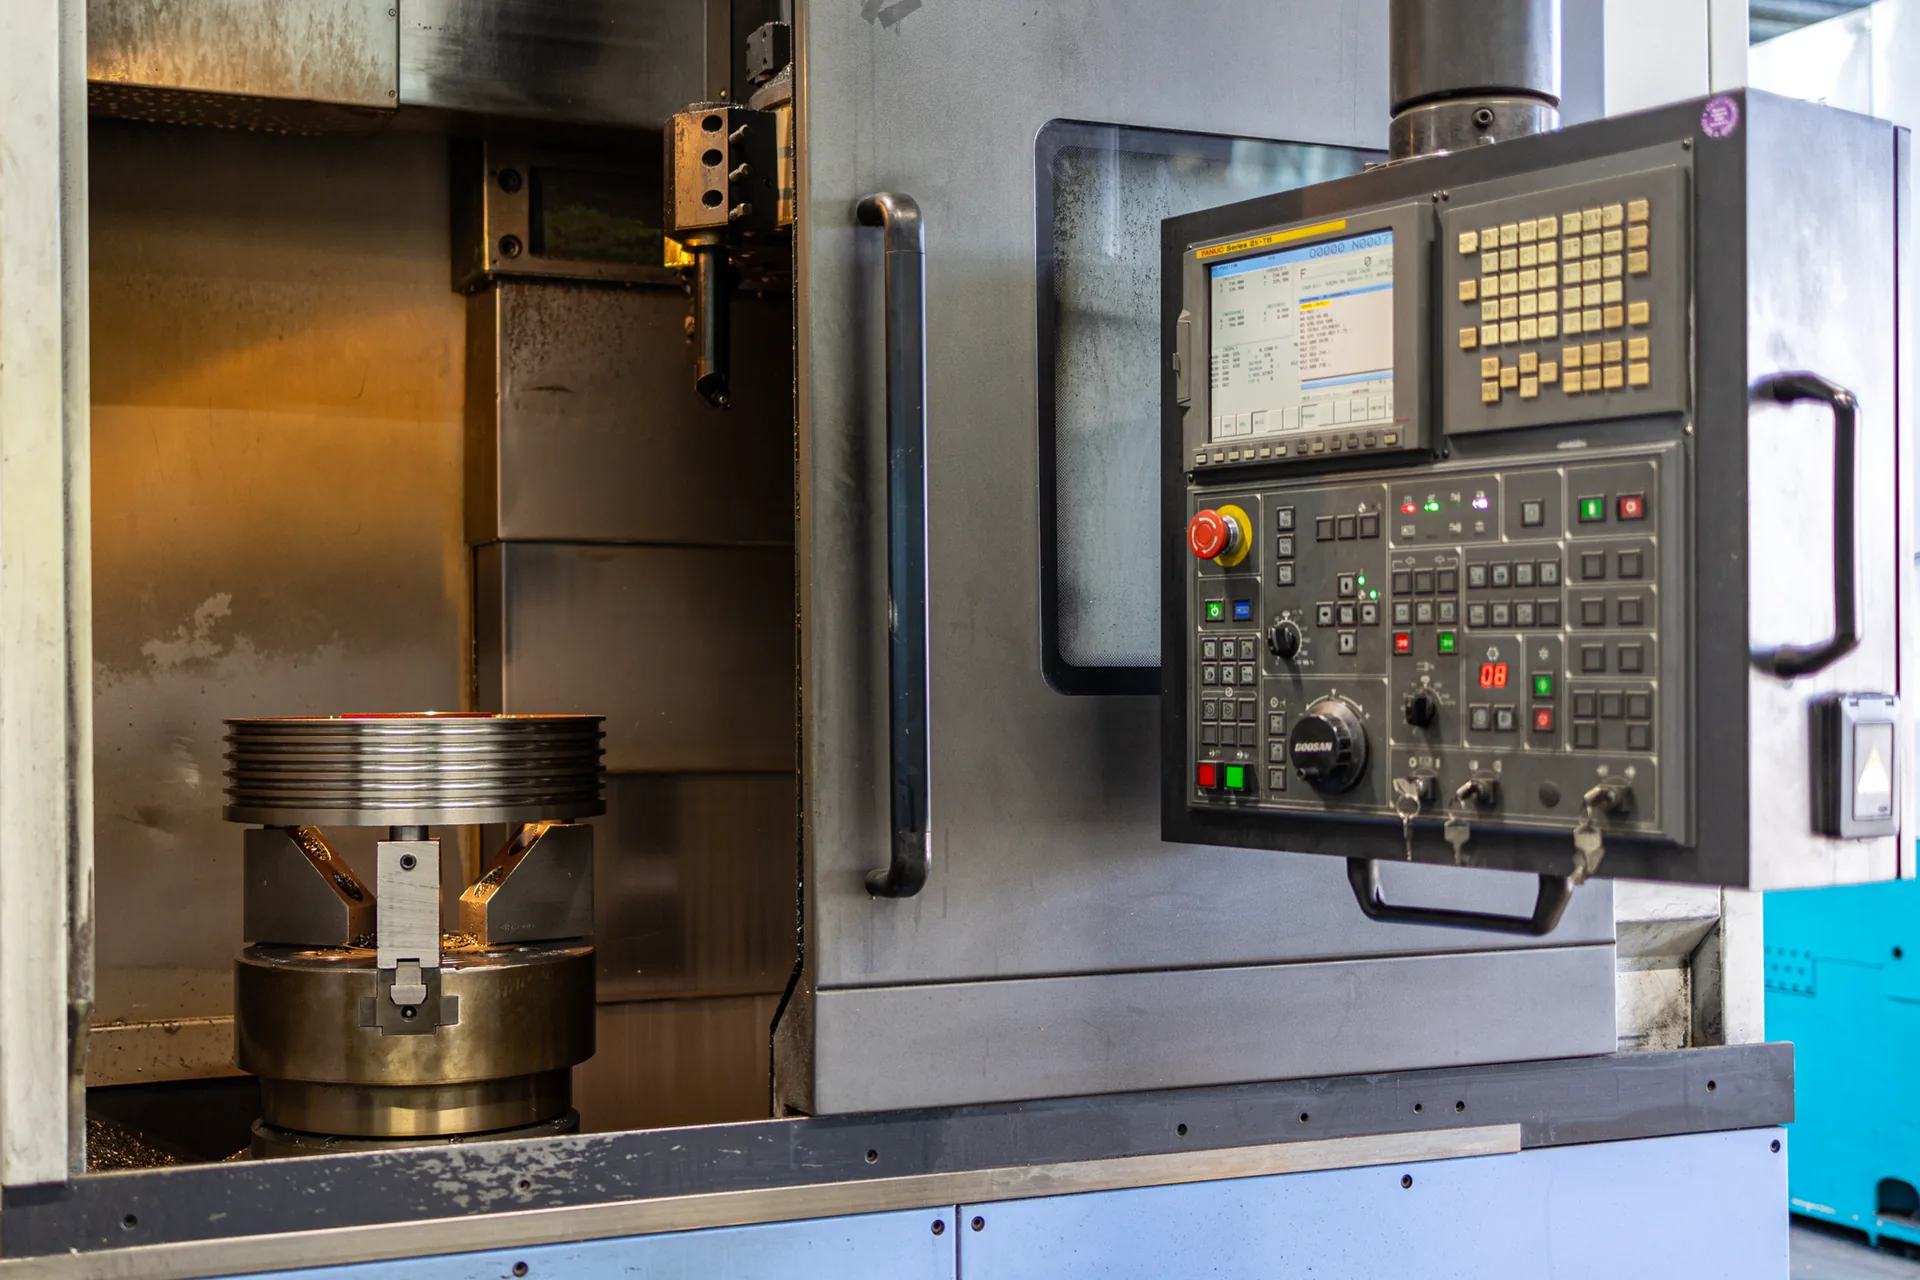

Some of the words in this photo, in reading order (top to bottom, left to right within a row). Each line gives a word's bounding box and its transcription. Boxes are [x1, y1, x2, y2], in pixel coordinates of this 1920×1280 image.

[1201, 246, 1224, 257] FANUC
[1226, 243, 1248, 252] Series
[1299, 267, 1308, 281] F
[1480, 662, 1508, 688] 08
[1294, 741, 1333, 752] DOOSAN
